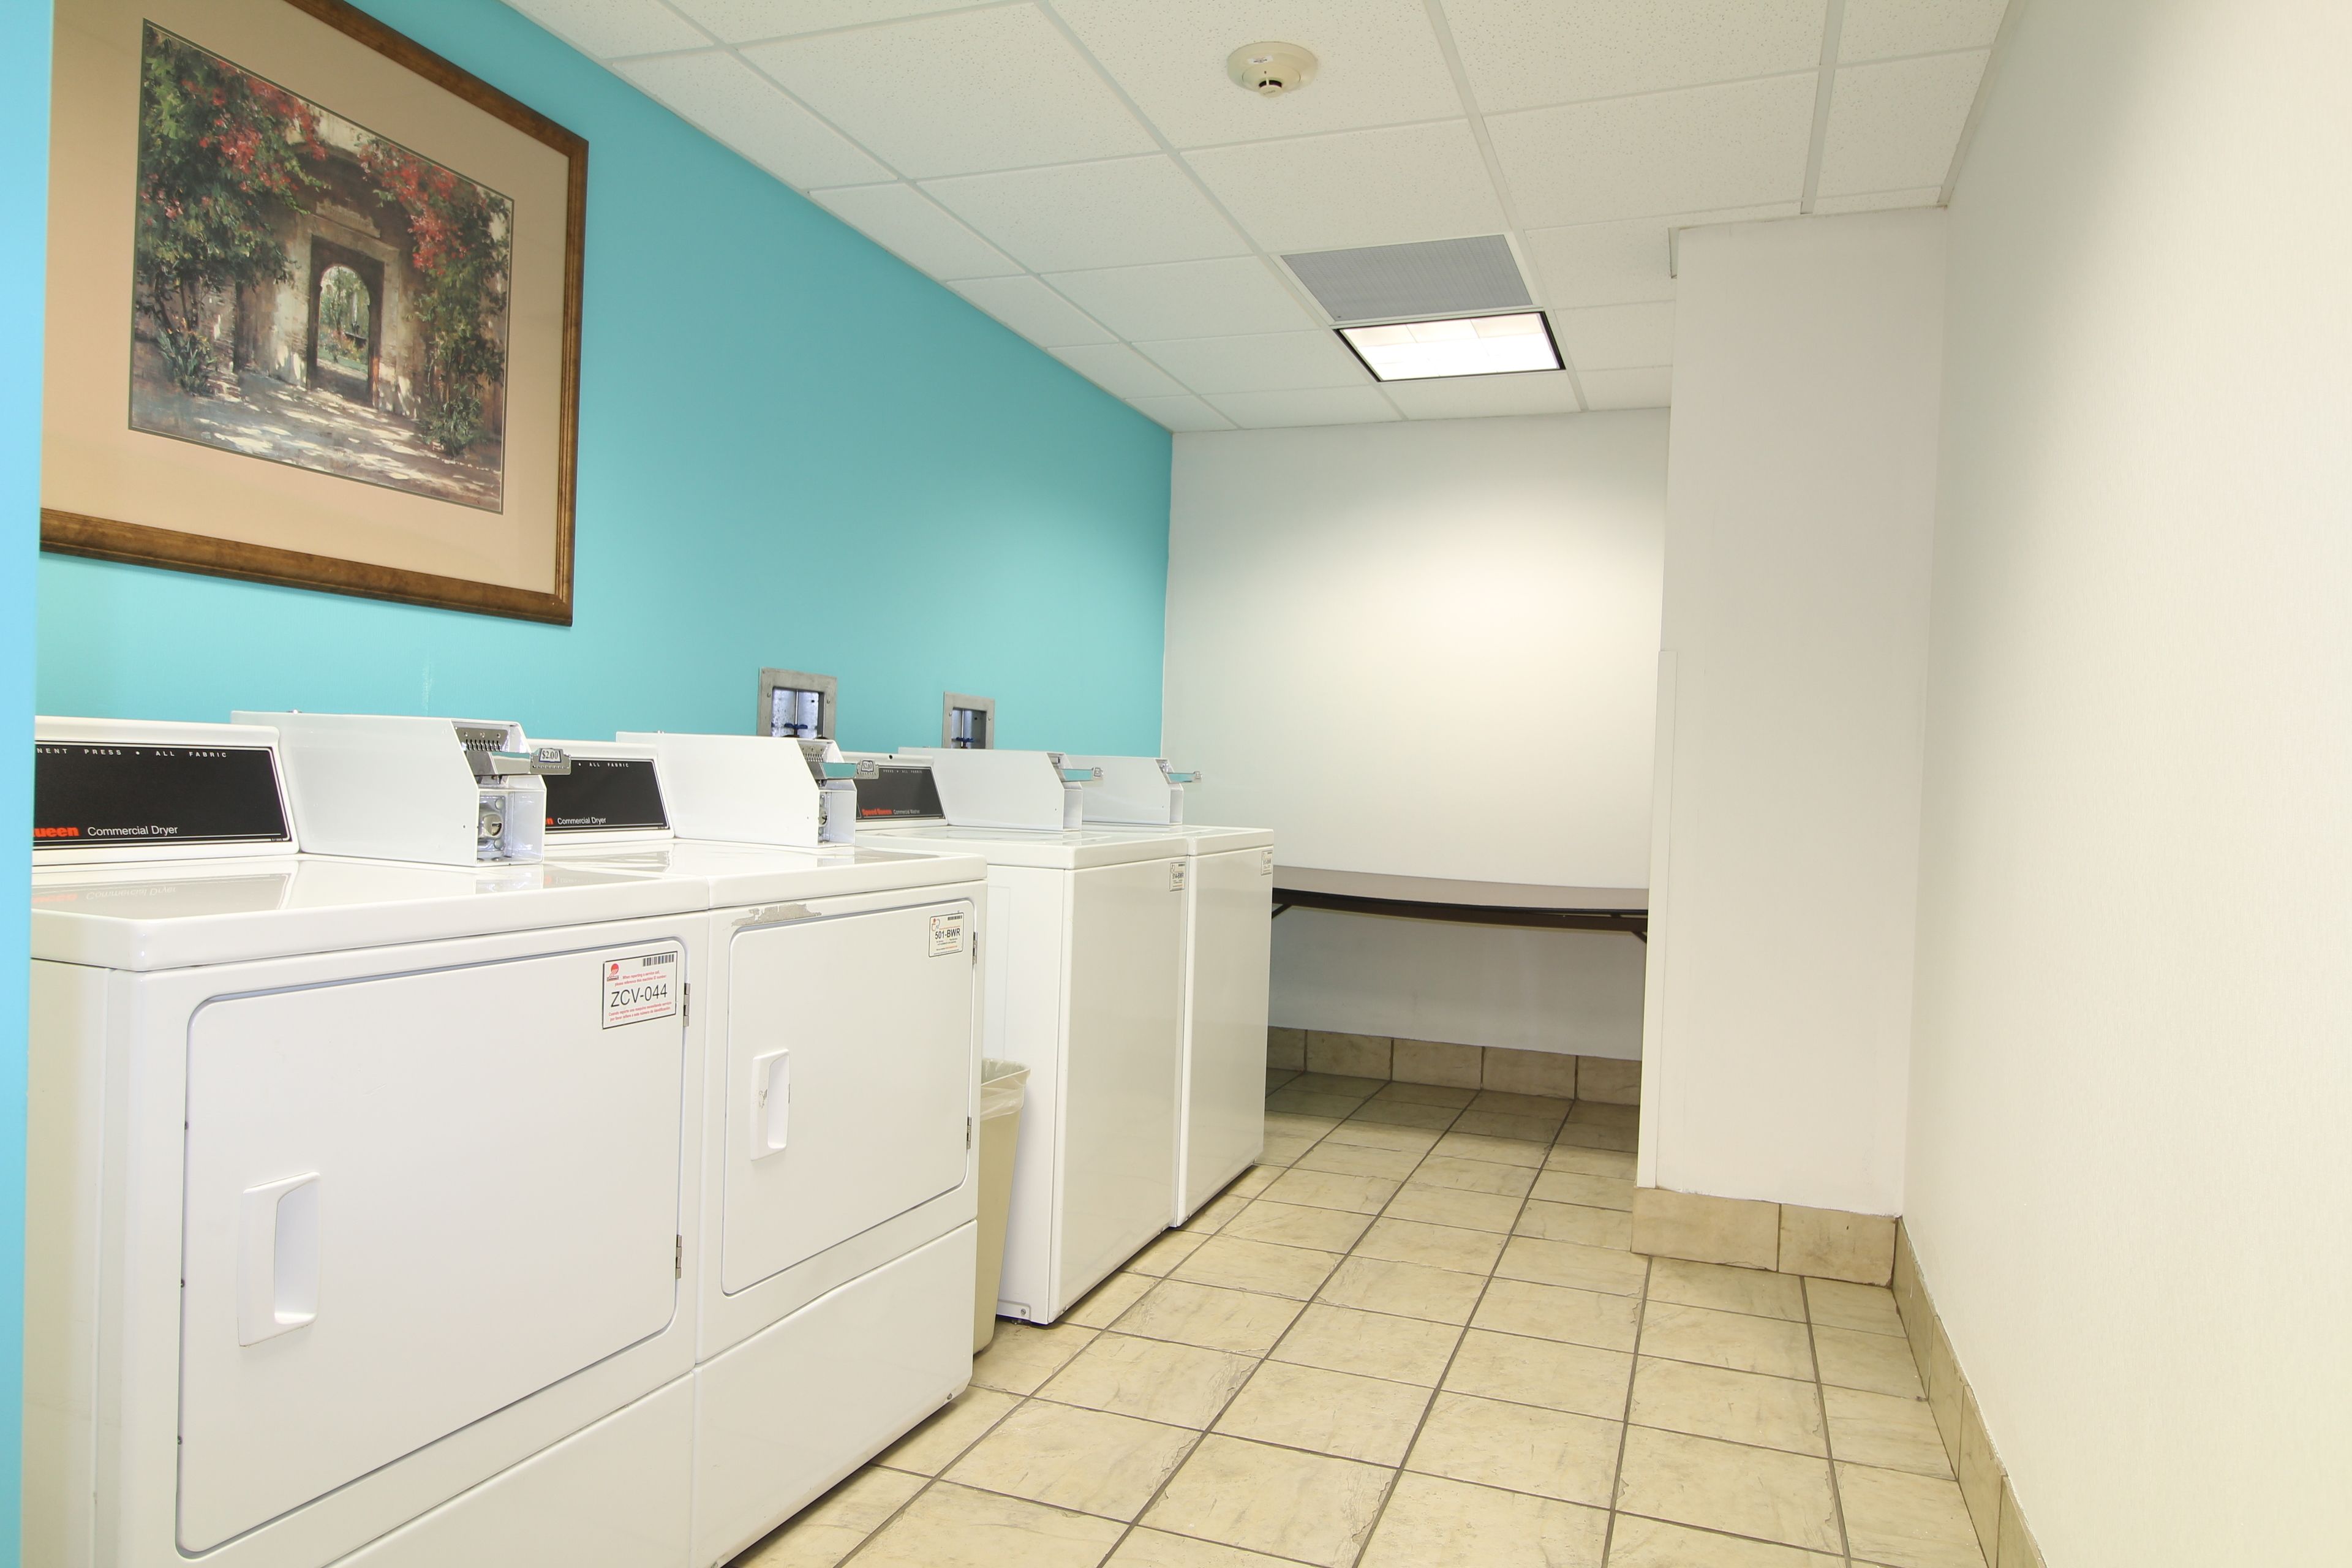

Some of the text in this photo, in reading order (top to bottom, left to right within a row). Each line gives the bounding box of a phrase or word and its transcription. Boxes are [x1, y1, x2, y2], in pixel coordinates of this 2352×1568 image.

[542, 750, 558, 760] $2.00
[557, 816, 590, 826] Commercial
[591, 816, 606, 826] Dryer
[34, 825, 178, 838] ueen Commercial Dryer
[935, 928, 960, 940] 501-BWR
[611, 983, 667, 1008] ZCV-044
